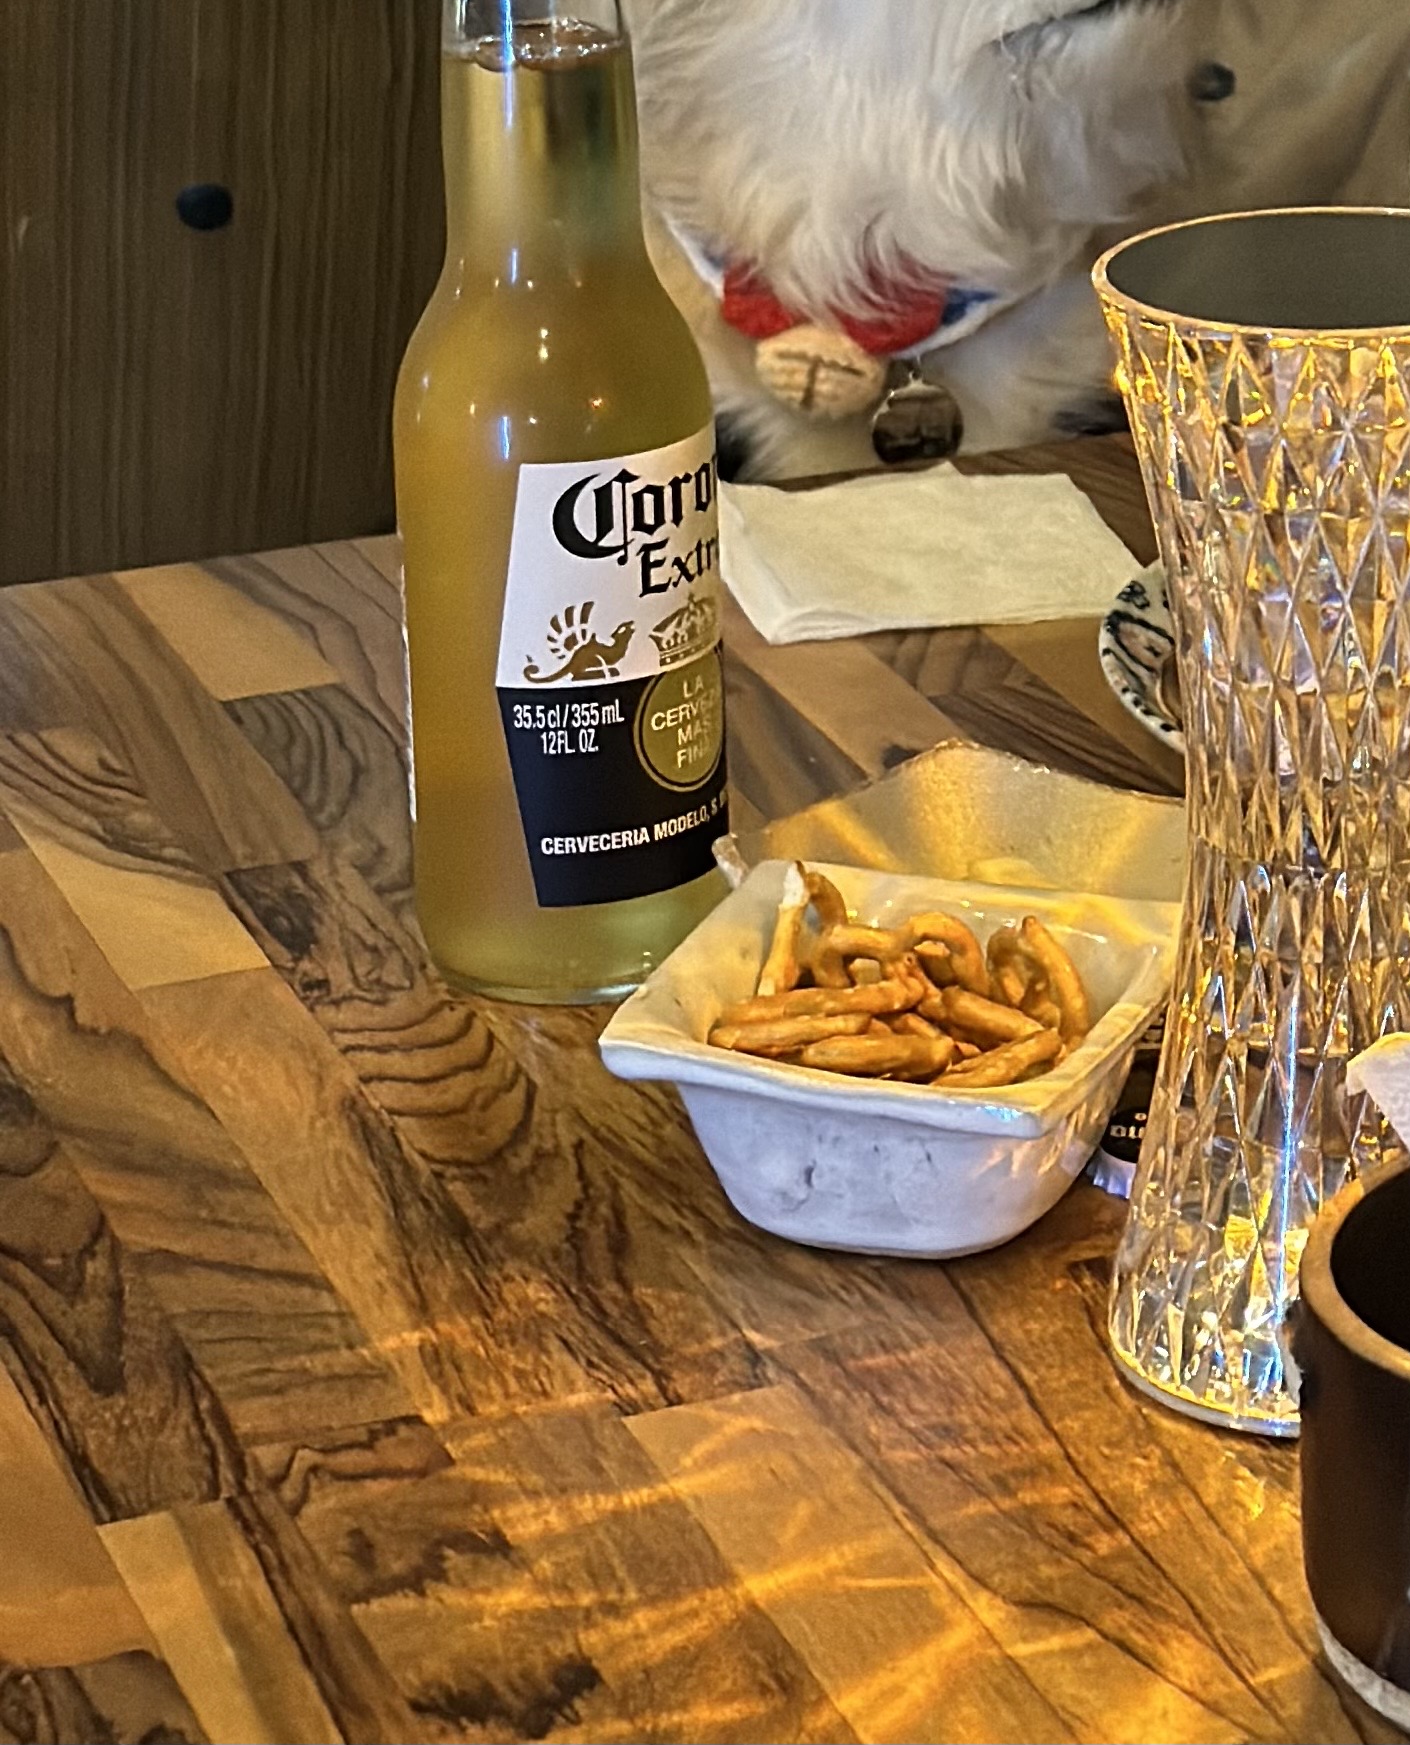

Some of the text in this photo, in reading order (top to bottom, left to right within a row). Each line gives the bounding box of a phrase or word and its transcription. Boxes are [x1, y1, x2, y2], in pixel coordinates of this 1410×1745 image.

[552, 456, 717, 566] Coro
[636, 537, 719, 598] Extr
[683, 674, 704, 699] LA
[541, 827, 650, 855] CERVECERIA
[653, 804, 710, 842] MODELO,
